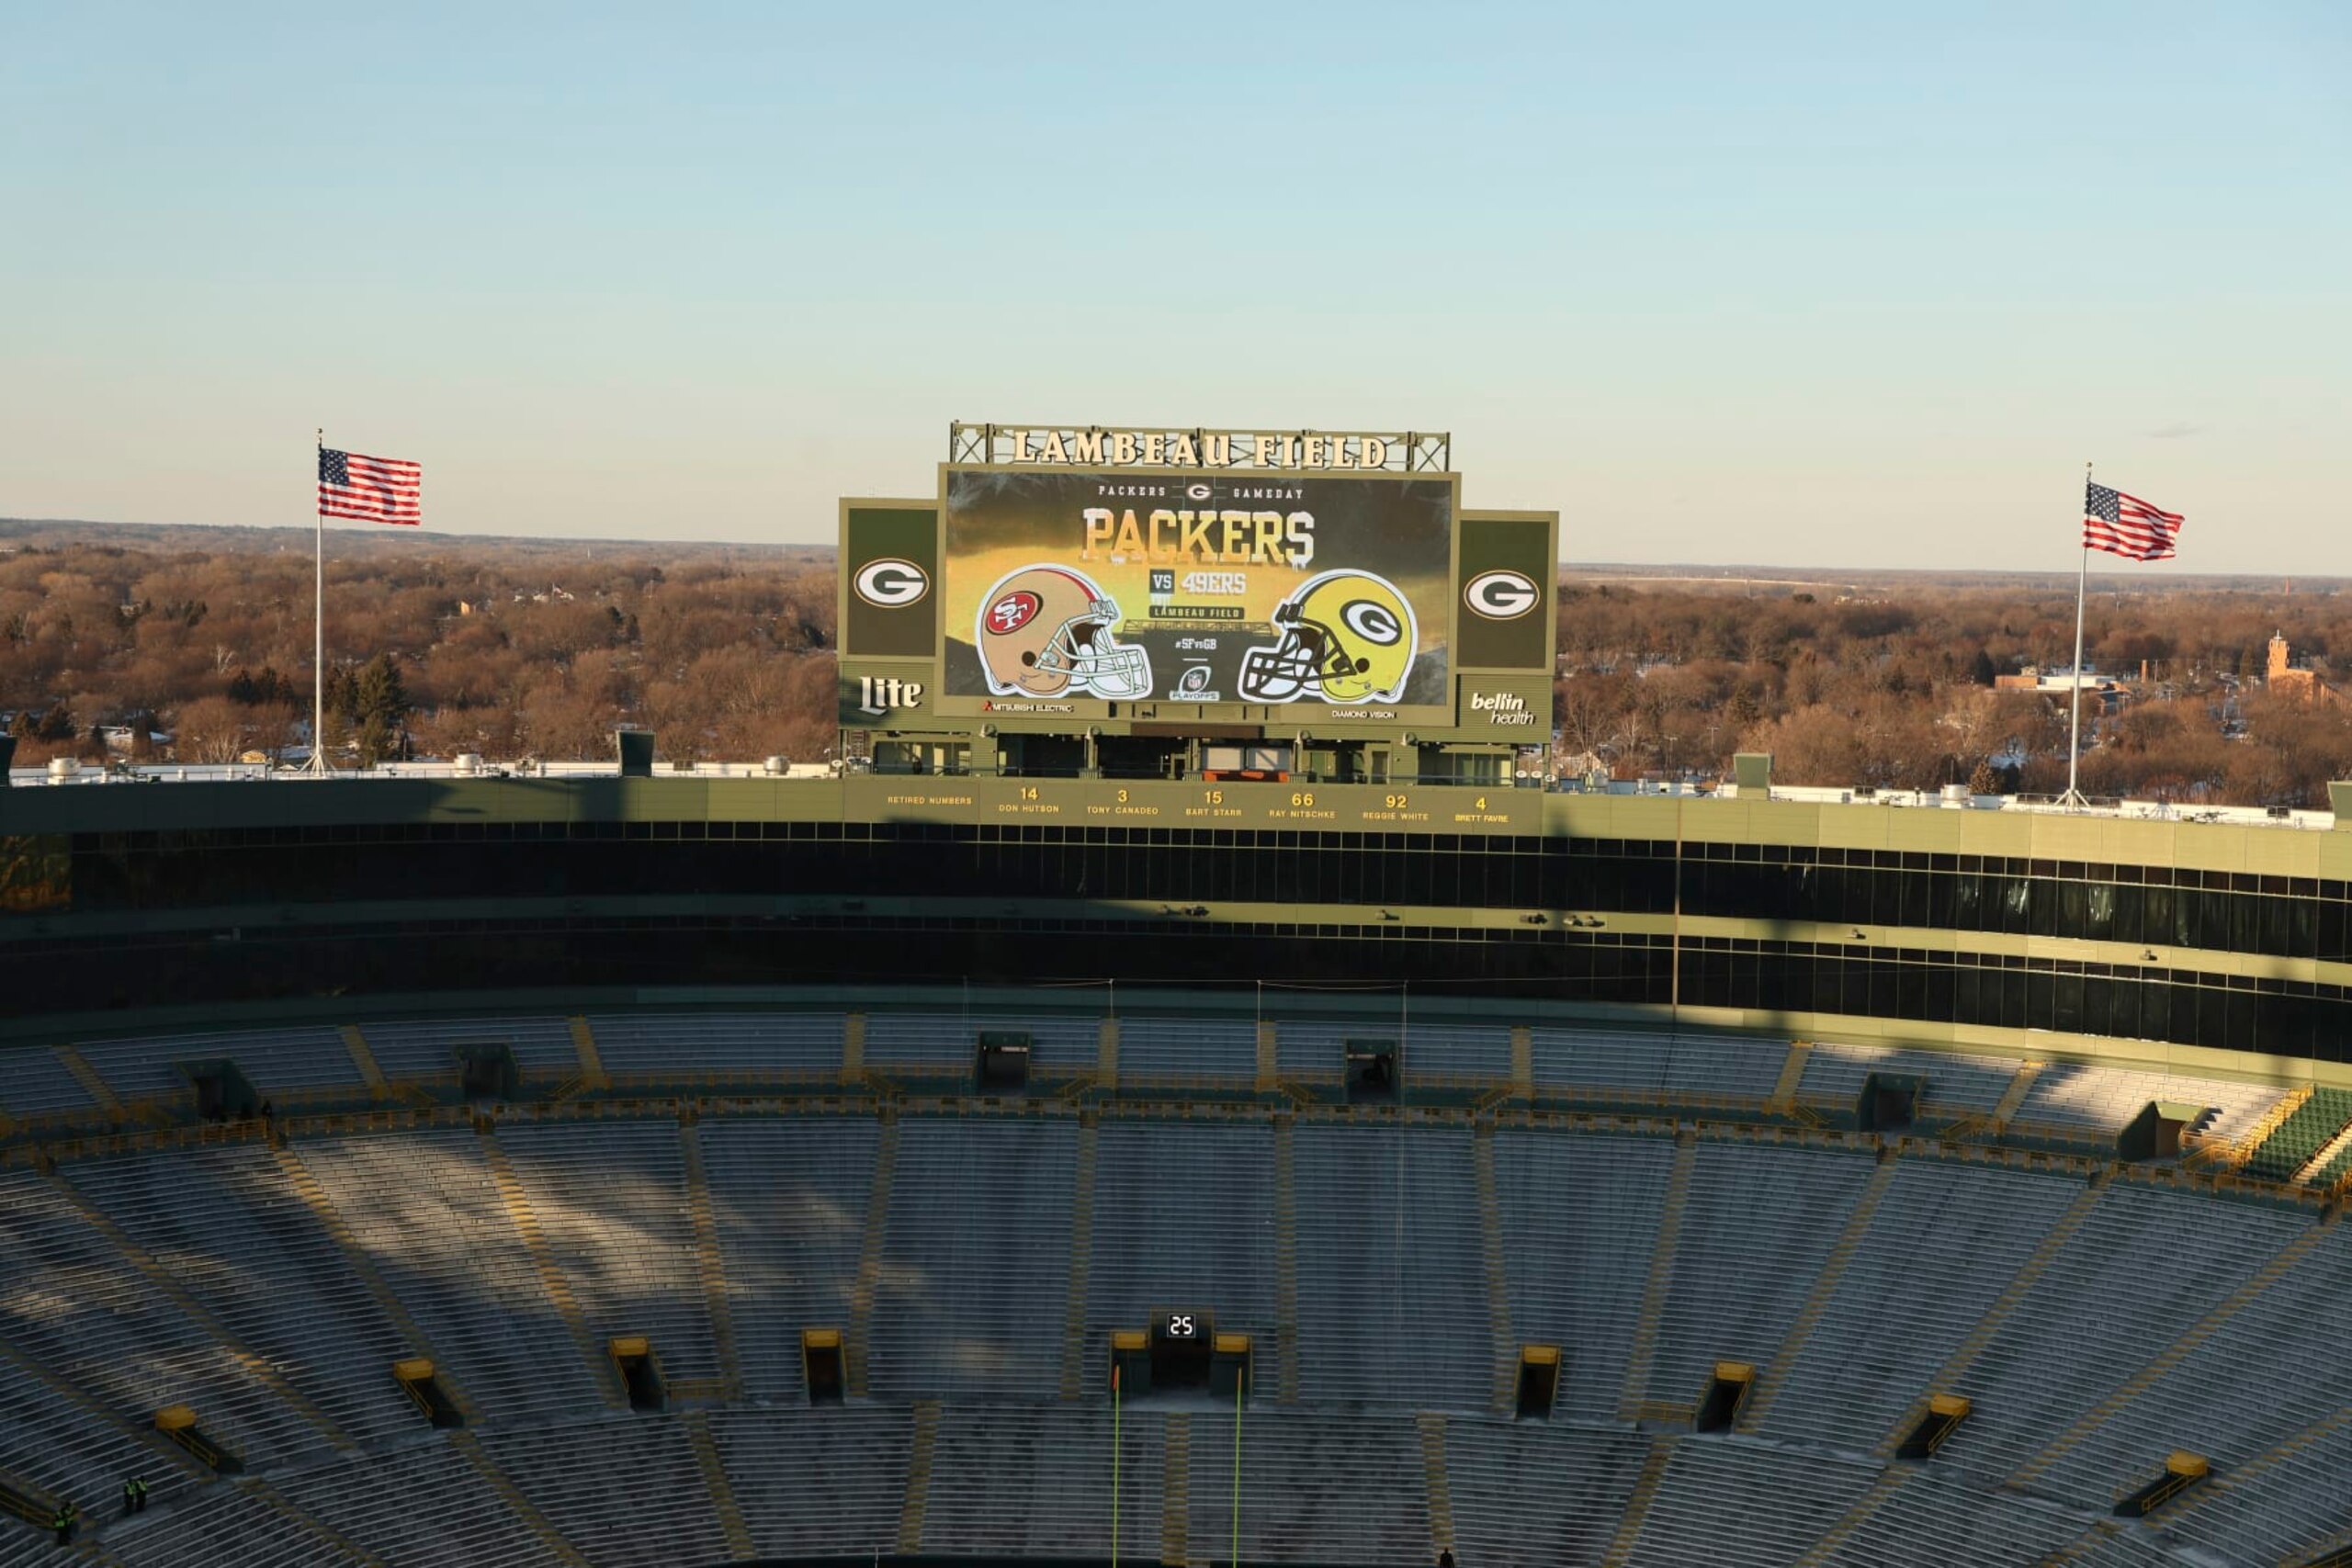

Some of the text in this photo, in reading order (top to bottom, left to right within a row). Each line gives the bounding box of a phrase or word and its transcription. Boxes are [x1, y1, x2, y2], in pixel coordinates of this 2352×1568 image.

[1014, 430, 1386, 469] LAMBEAU FIELD
[1098, 485, 1166, 497] PACKERS
[1234, 488, 1304, 500] GAMEDAY
[1082, 508, 1315, 567] PACKERS
[1152, 574, 1172, 590] VS
[1181, 571, 1247, 595] 49ERS
[1154, 607, 1240, 618] LAMBEAU FIELD
[858, 676, 923, 717] Lite
[1171, 691, 1217, 700] PLAYOFFS
[1471, 693, 1525, 711] bellin
[992, 702, 1073, 713] MITSUBISHI ELECTRIC
[1331, 709, 1396, 719] DIAMOND VISION
[1490, 709, 1535, 725] health
[888, 796, 972, 805] RETIRED NUMBERS
[1020, 787, 1039, 801] 14
[1118, 789, 1128, 803] 3
[1204, 791, 1223, 804] 15
[1291, 793, 1314, 807] 66
[1385, 795, 1408, 808] 92
[1476, 797, 1487, 810] 4
[999, 804, 1059, 813] DON HUTSON
[1087, 806, 1159, 815] TONY CANADEO
[1185, 807, 1242, 817] BART STARR
[1269, 809, 1336, 819] RAY NITSCHKE
[1363, 811, 1429, 821] REGGIE WHITE
[1454, 815, 1509, 823] BRETT FAVRE
[1170, 1315, 1193, 1335] 25
